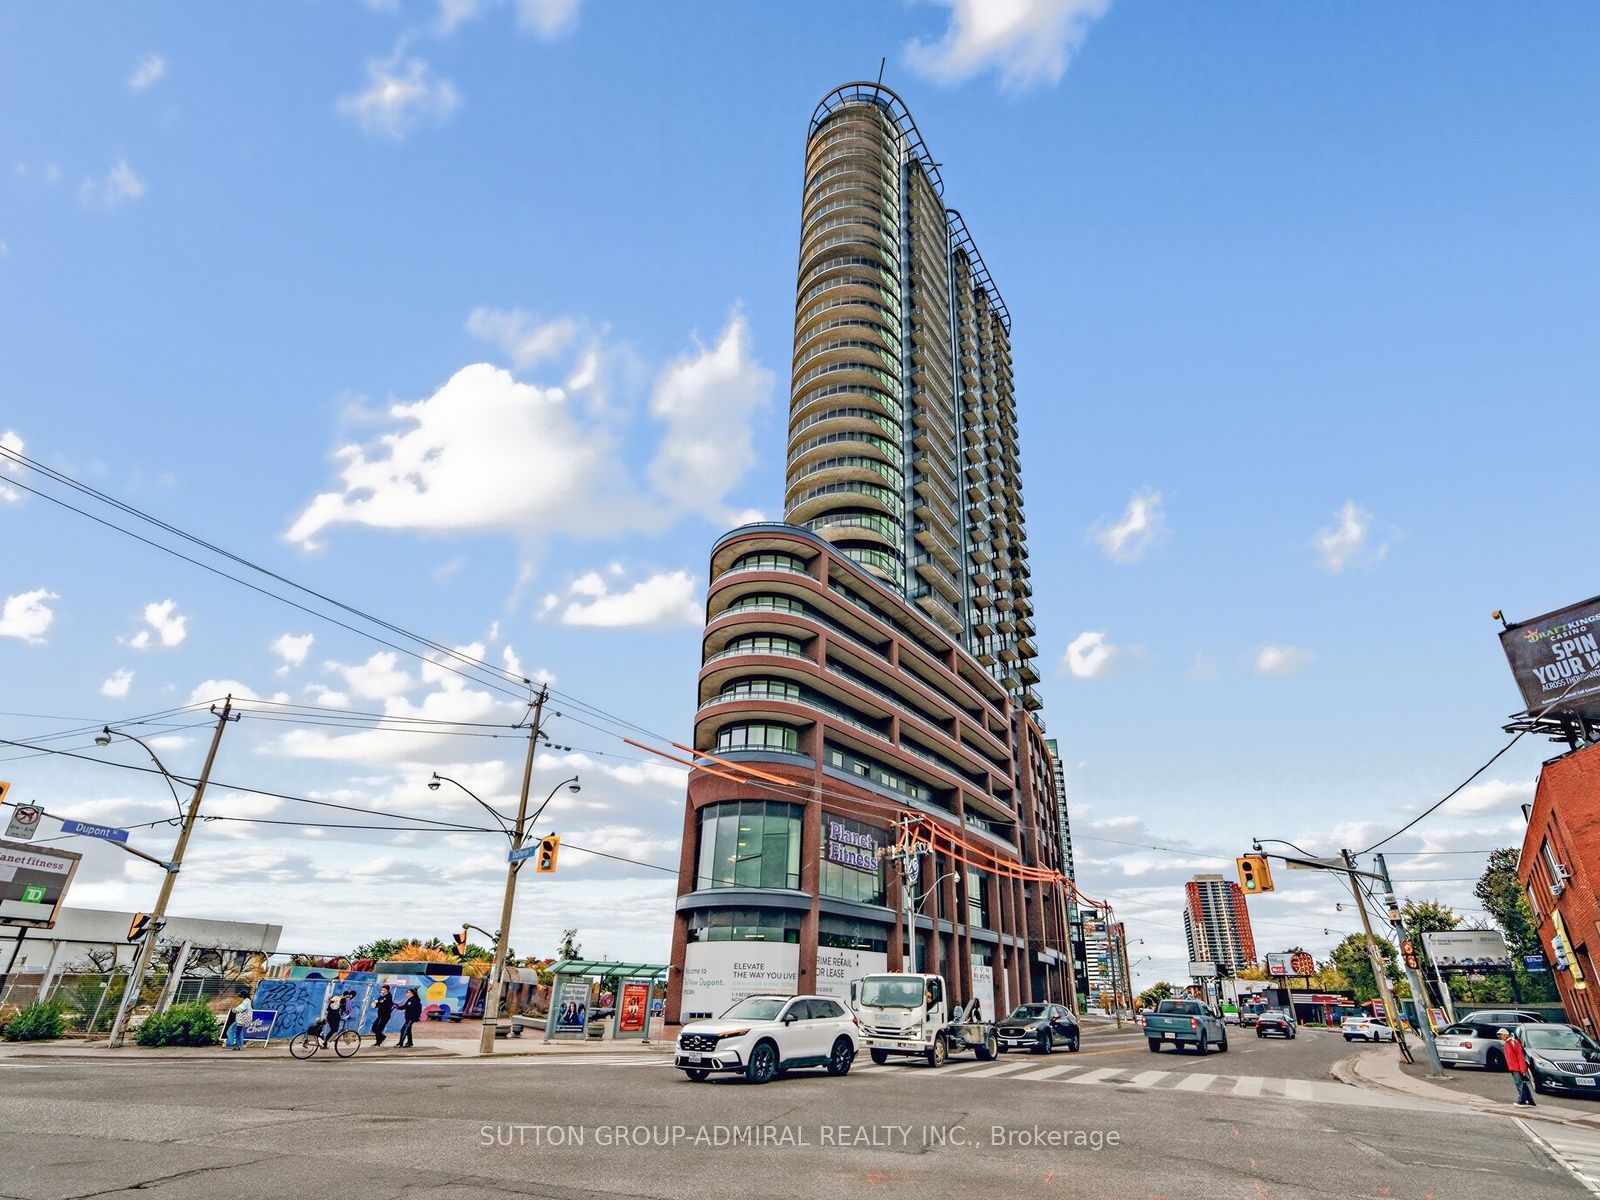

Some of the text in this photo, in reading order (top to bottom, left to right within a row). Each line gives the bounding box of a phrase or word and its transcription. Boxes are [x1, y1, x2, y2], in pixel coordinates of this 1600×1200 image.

[1550, 626, 1587, 642] CASINO
[1551, 633, 1598, 661] SPIN
[1532, 657, 1587, 685] YOUR
[1542, 679, 1567, 692] ACROSS
[76, 823, 110, 838] Dupont
[830, 821, 873, 849] Planet
[829, 841, 877, 869] Fitness
[26, 856, 64, 870] fitness
[27, 889, 42, 900] TD
[733, 963, 765, 971] ELEVATE
[832, 957, 852, 968] RETAIL
[733, 971, 748, 979] THE
[766, 972, 782, 980] YOU
[783, 972, 797, 980] LIVE
[826, 968, 845, 978] LEASE
[246, 1024, 270, 1034] Chow
